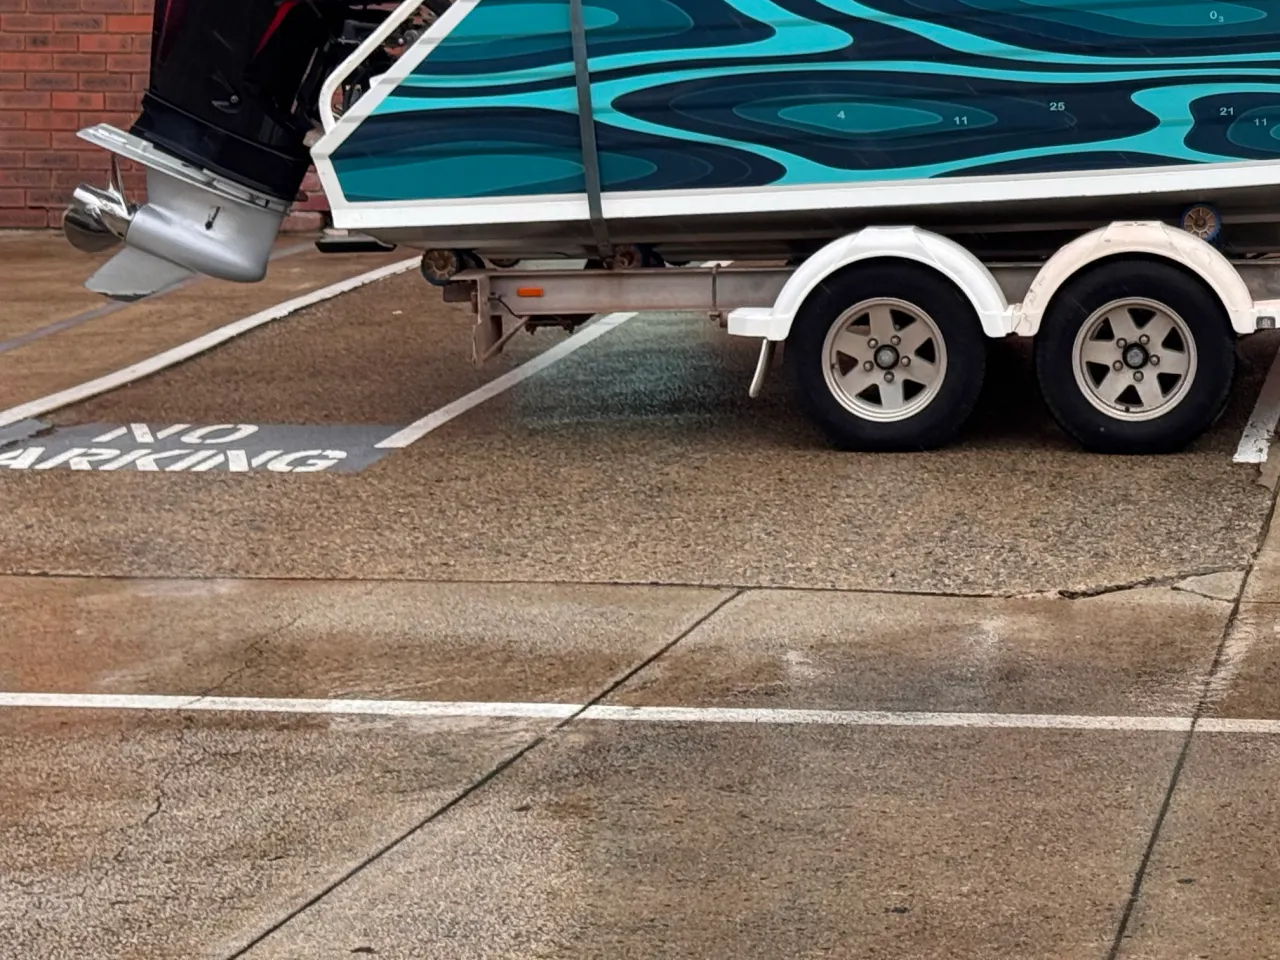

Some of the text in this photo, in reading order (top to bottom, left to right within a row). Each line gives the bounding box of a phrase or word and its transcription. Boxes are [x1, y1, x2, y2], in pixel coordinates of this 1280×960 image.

[1049, 101, 1066, 111] 25
[1219, 106, 1234, 116] 21
[836, 110, 846, 120] 4
[953, 116, 968, 125] 11
[1253, 117, 1267, 126] 11
[92, 422, 260, 445] NO
